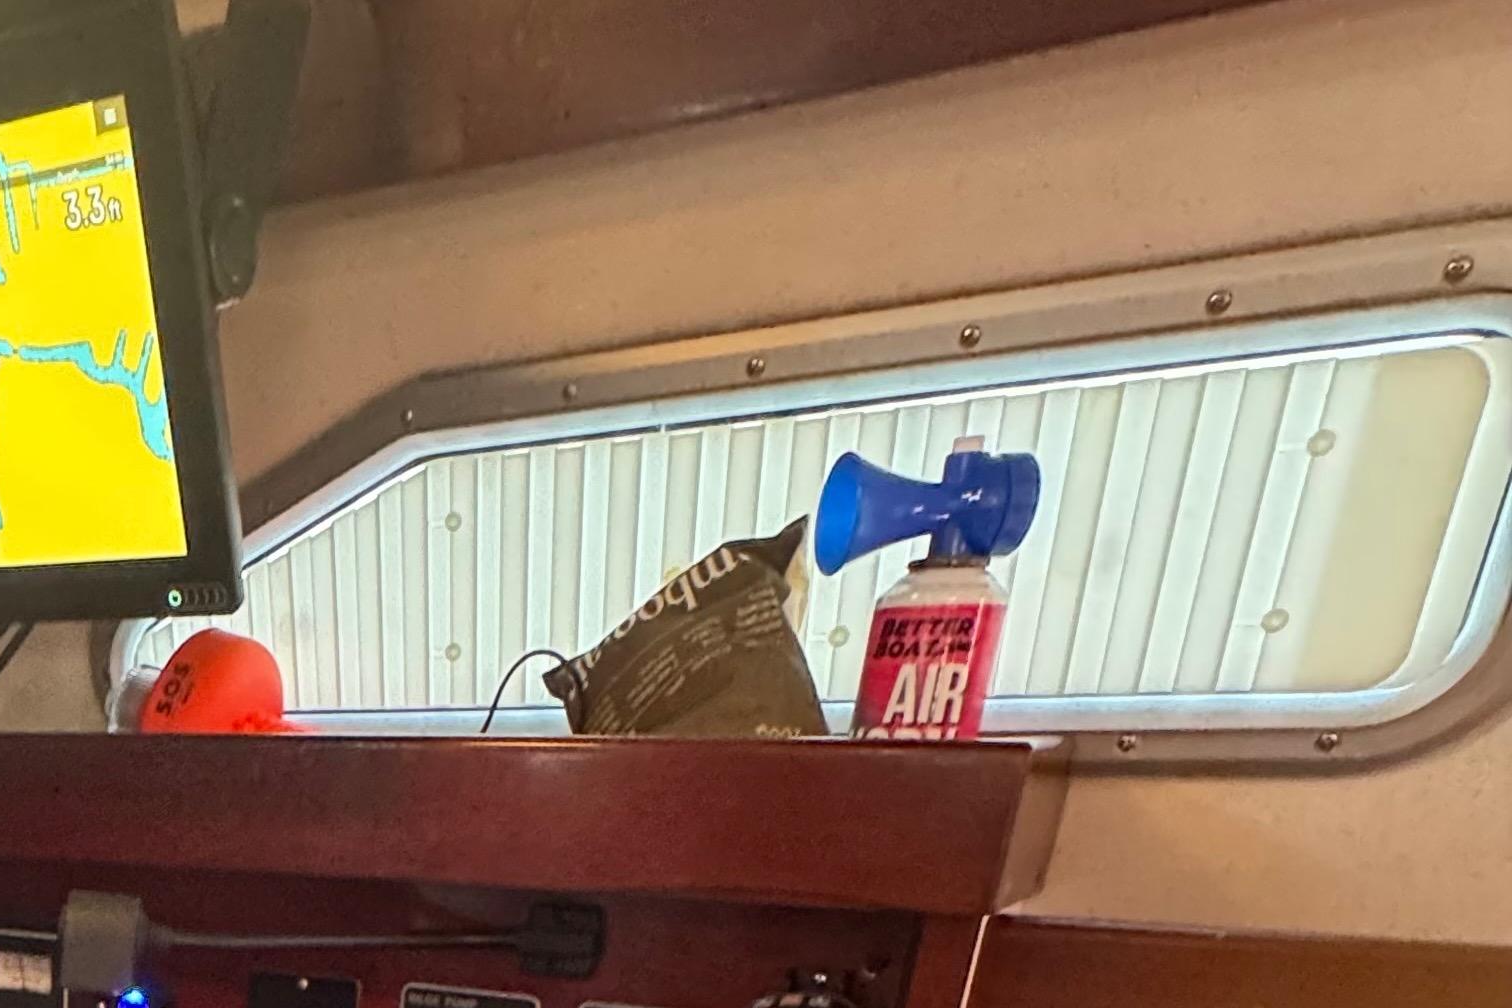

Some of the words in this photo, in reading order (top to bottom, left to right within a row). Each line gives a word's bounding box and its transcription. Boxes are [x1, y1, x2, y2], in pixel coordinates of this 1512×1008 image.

[881, 617, 975, 637] BETTER
[156, 662, 191, 717] SOS
[881, 660, 970, 725] AIR
